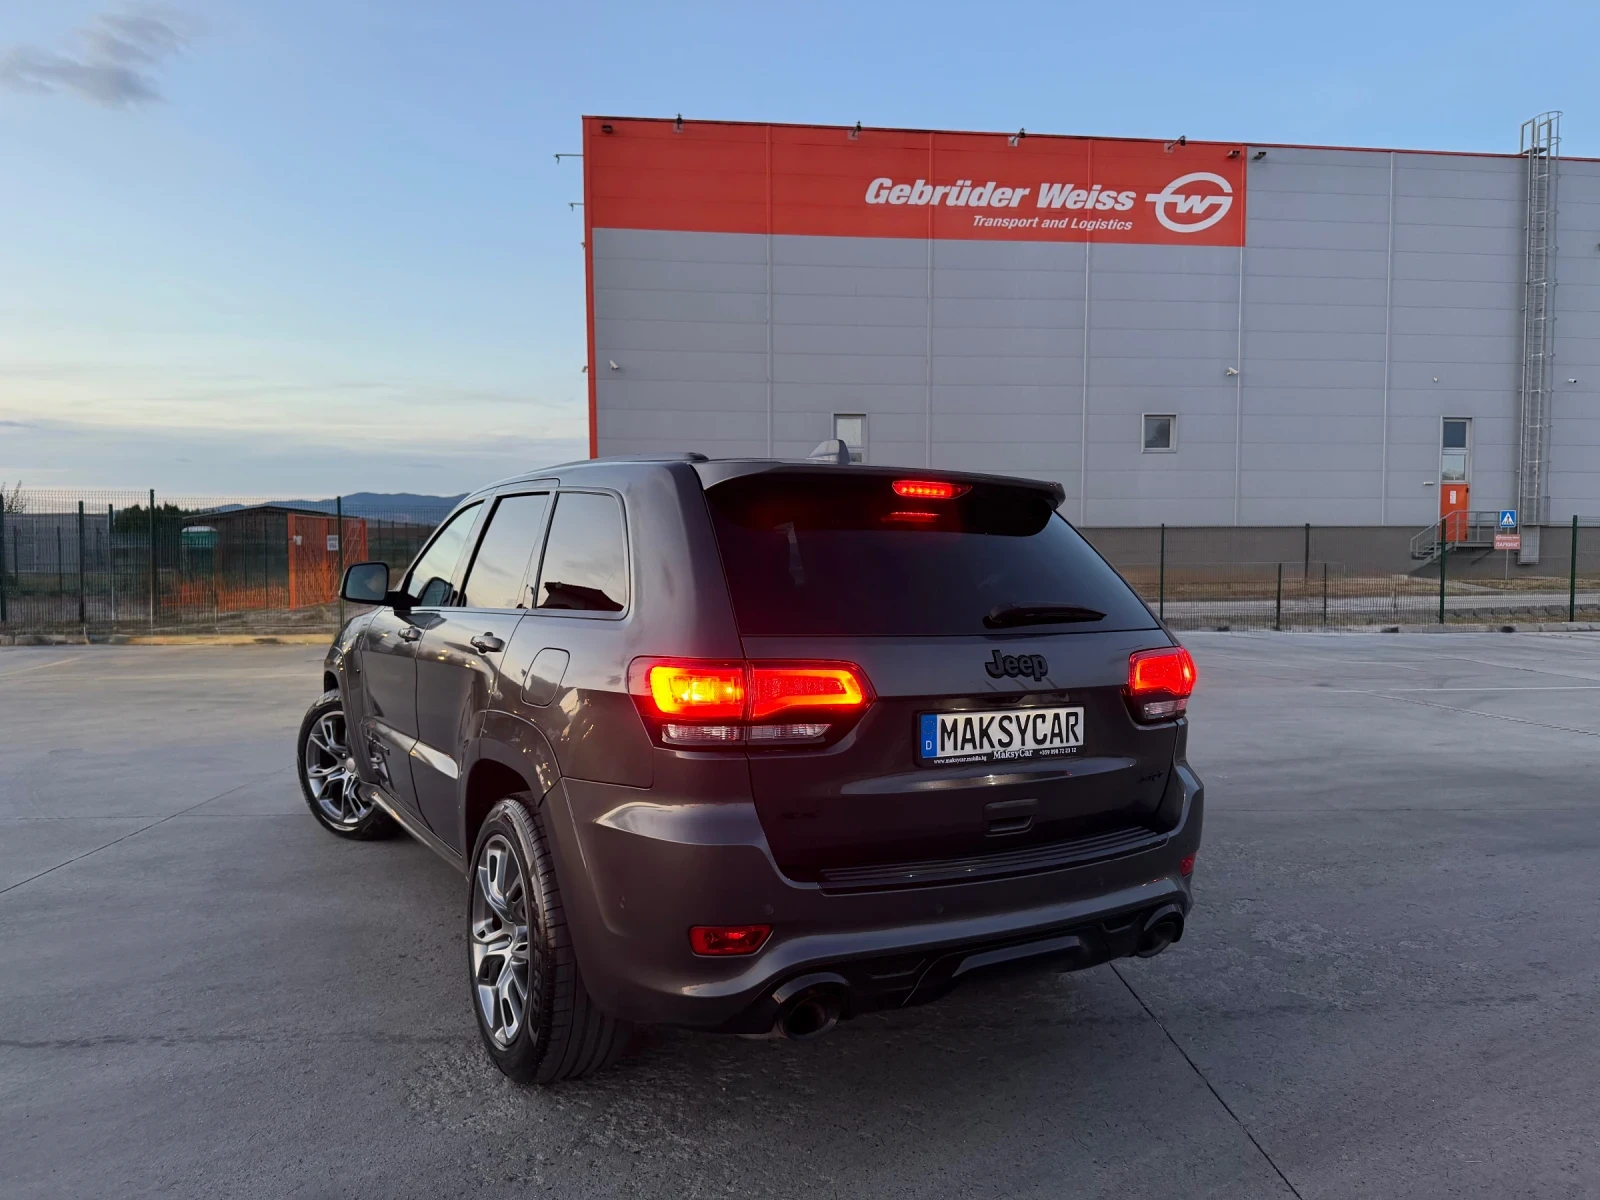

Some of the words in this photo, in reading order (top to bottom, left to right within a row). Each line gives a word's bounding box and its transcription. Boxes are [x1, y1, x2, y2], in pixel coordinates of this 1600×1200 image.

[865, 177, 1031, 209] Gebrüder
[1037, 182, 1137, 211] Weiss
[972, 215, 1039, 229] Transport
[1041, 217, 1068, 230] and
[1070, 217, 1133, 231] Logistics
[985, 649, 1048, 682] Jeep
[925, 740, 933, 751] D
[940, 712, 1080, 752] MAKSYCAR
[993, 749, 1033, 761] MaksyCar
